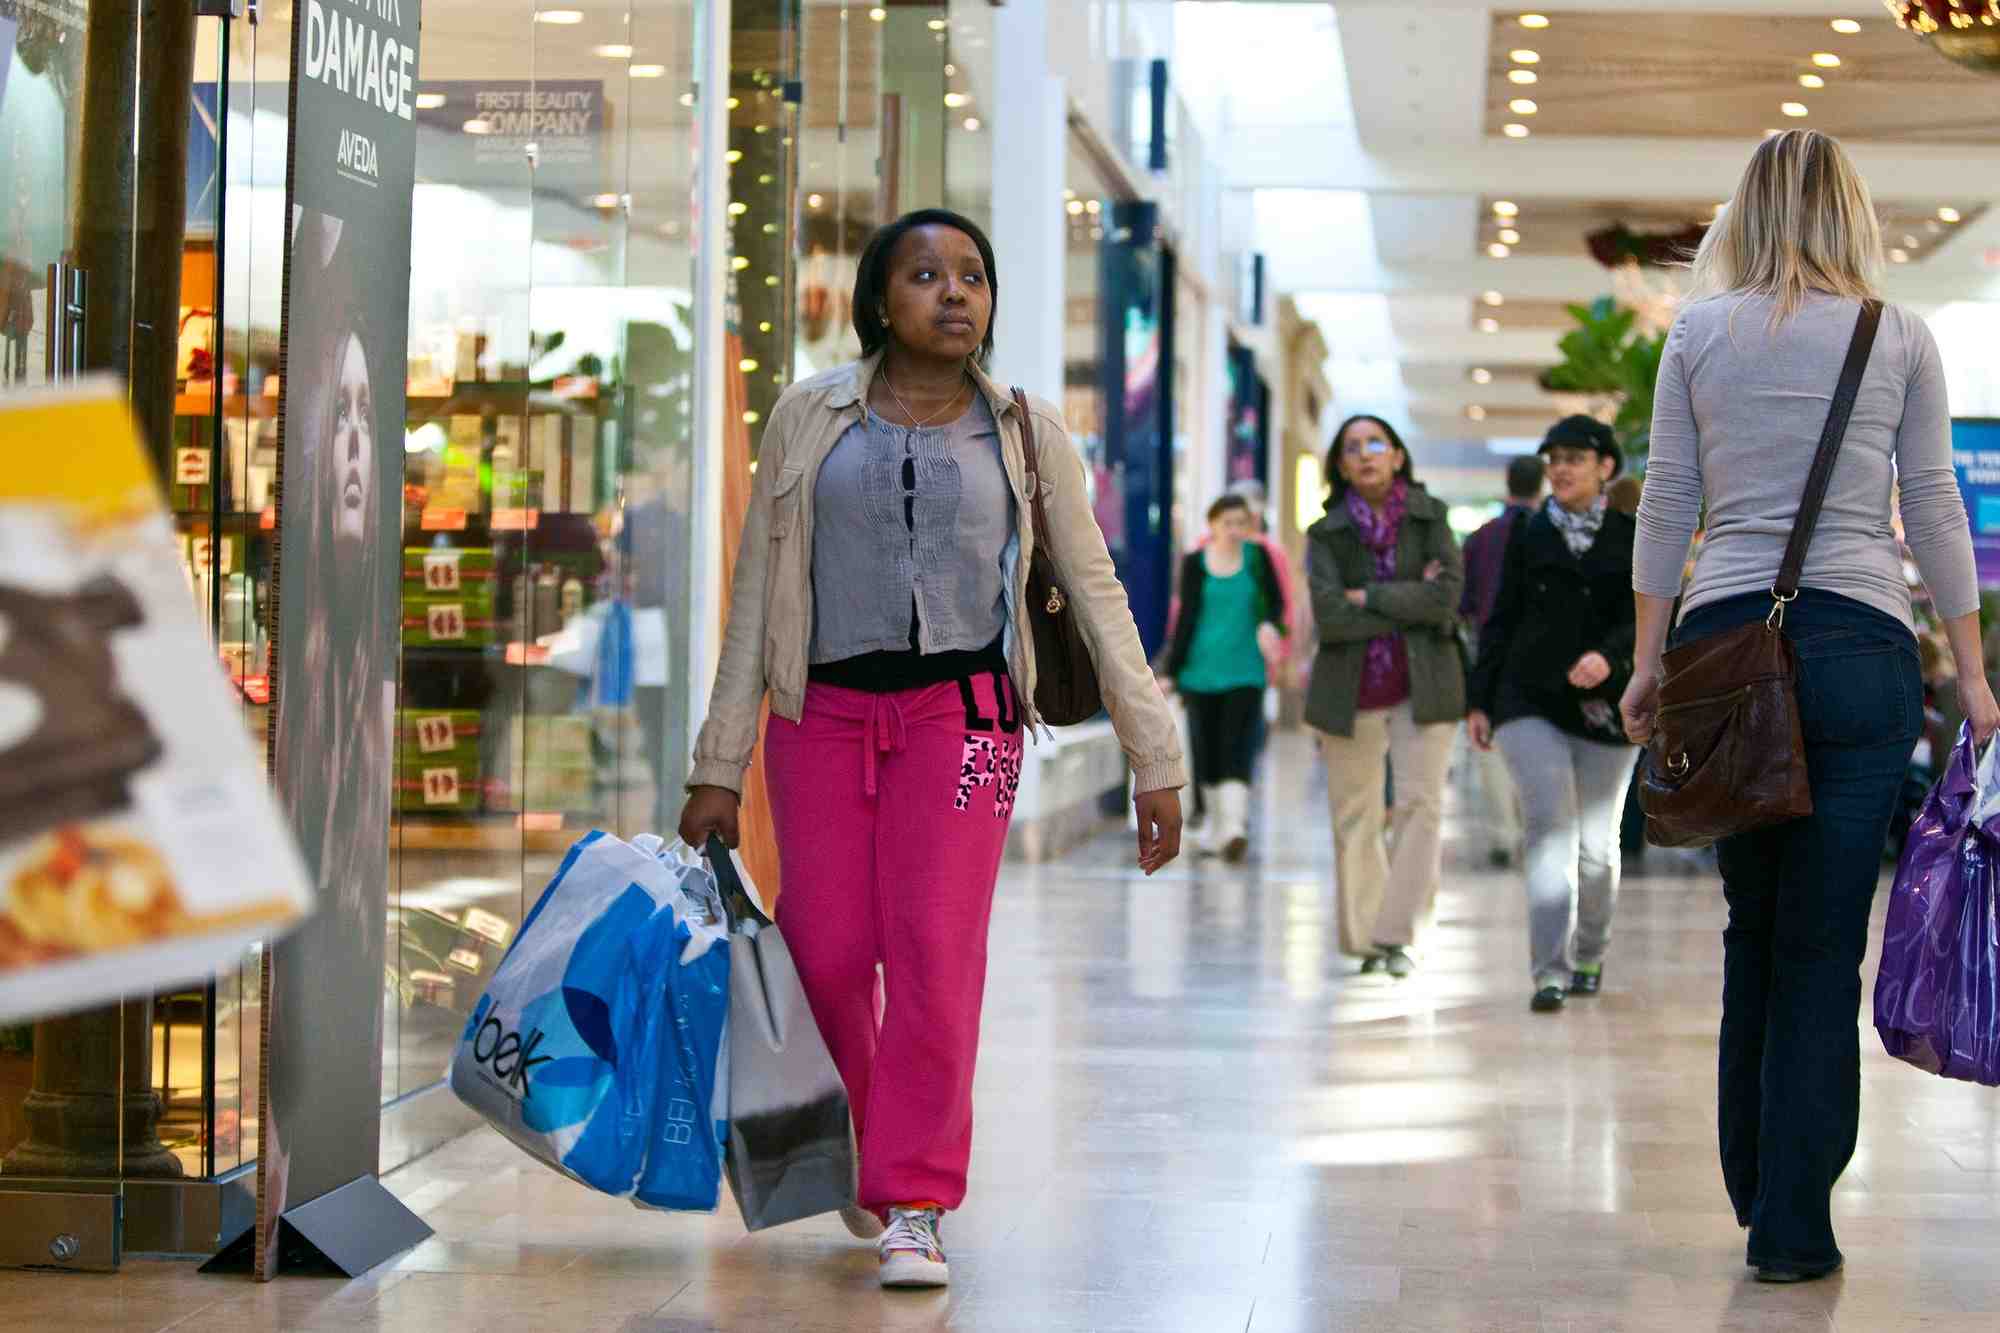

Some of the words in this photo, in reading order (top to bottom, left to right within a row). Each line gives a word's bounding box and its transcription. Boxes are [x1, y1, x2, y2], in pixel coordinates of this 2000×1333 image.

[306, 0, 414, 120] DAMAGE
[475, 91, 520, 109] FIRST
[523, 91, 592, 110] BEAUTY
[337, 128, 378, 177] AVEDA
[474, 1000, 555, 1099] belk
